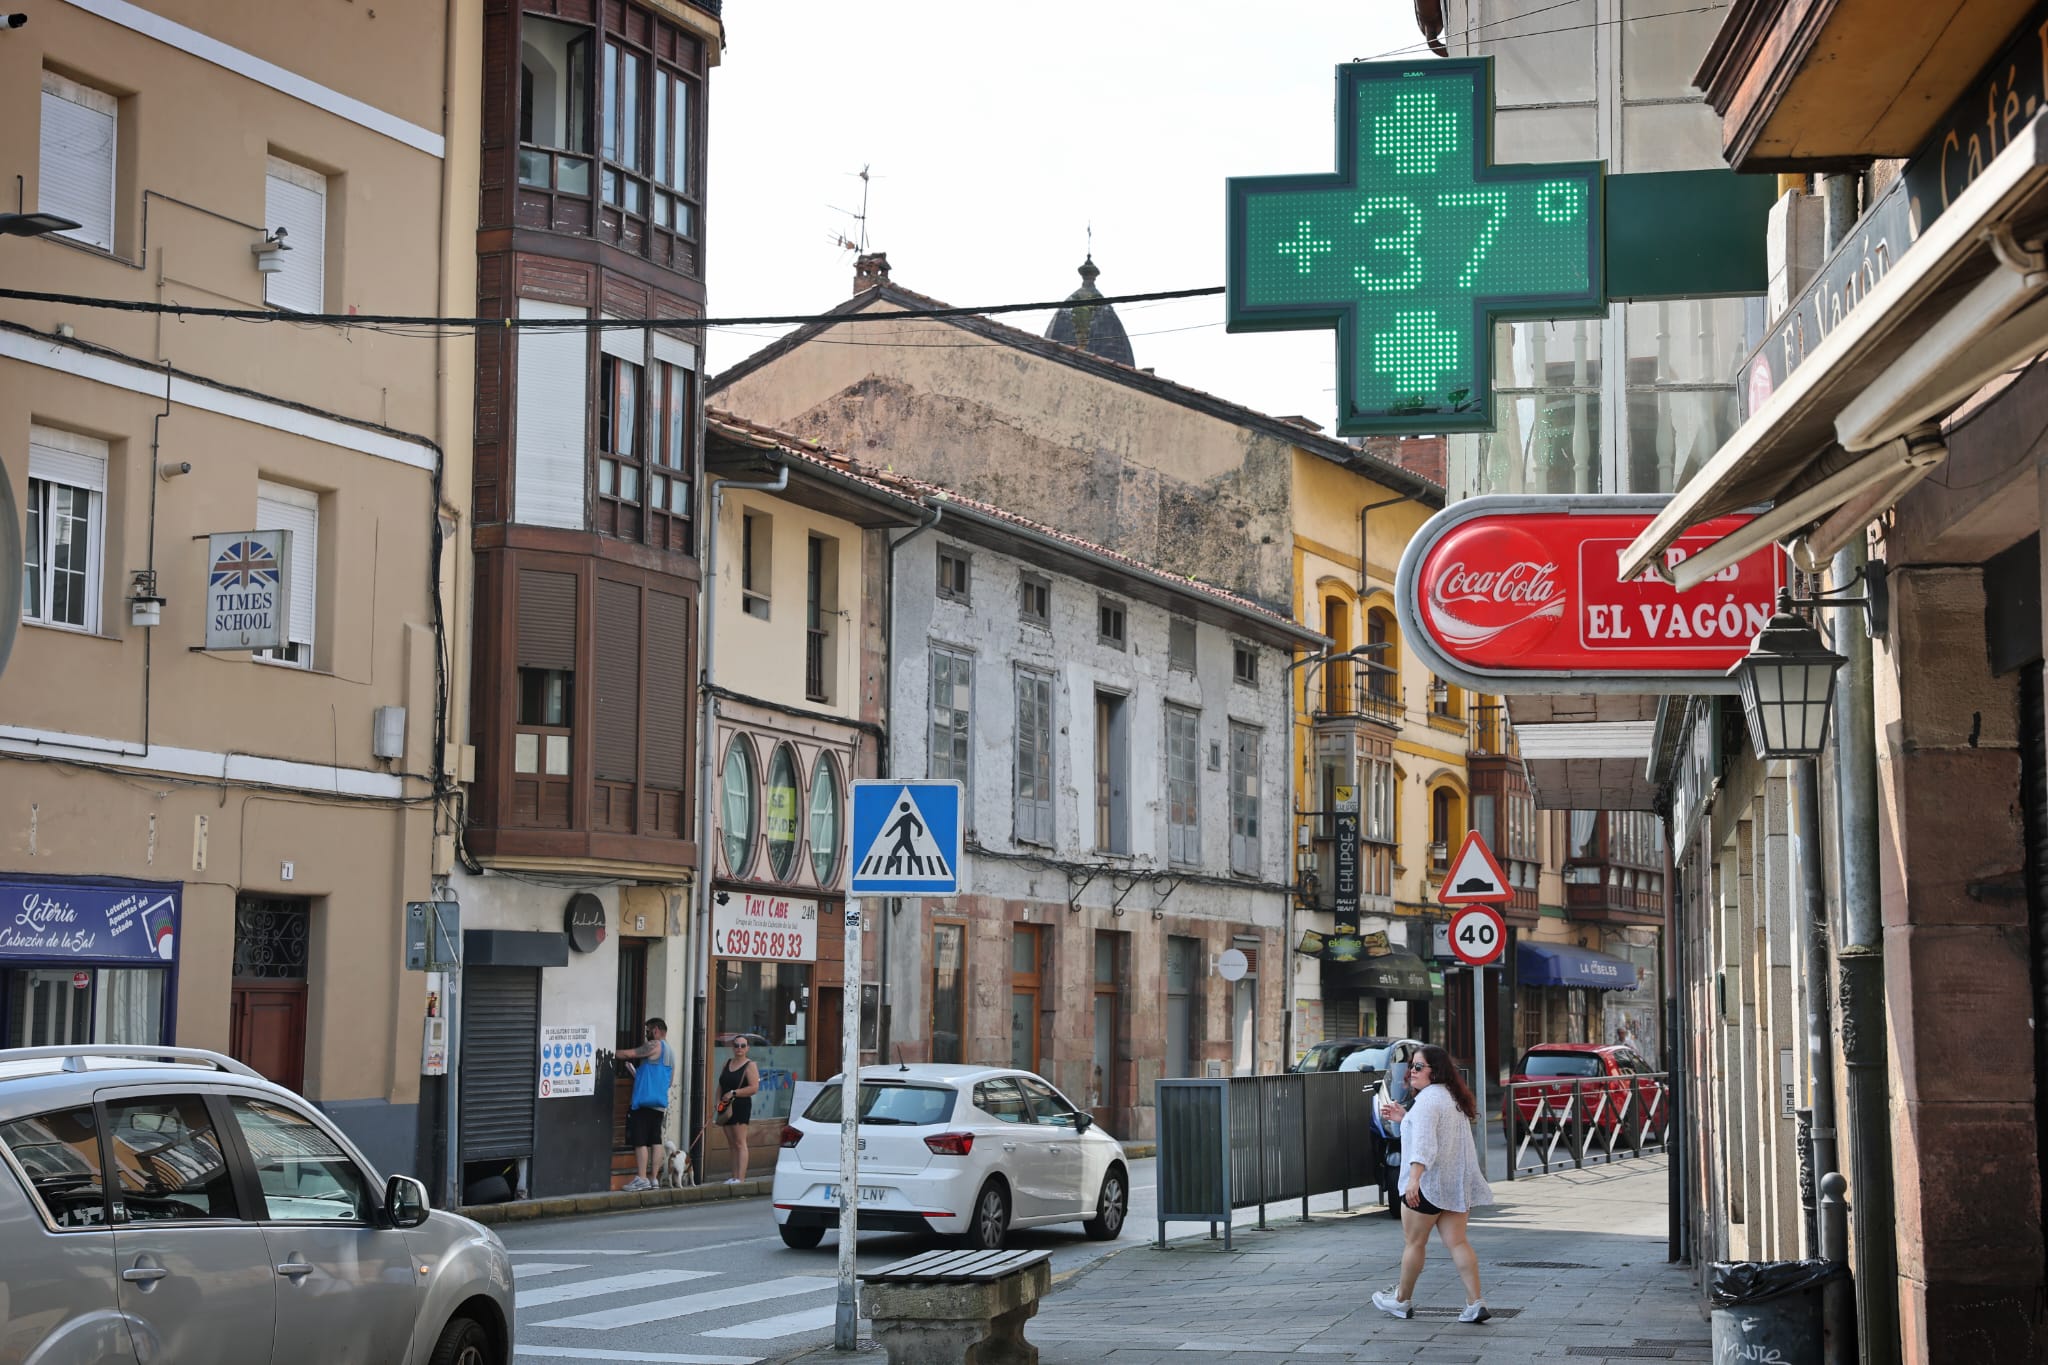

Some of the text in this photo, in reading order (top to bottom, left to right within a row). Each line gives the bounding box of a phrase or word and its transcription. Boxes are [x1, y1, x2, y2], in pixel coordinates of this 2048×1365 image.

[1435, 562, 1559, 603] Coca-Cola
[216, 592, 272, 612] TIMES
[215, 612, 272, 632] SCHOOL
[1588, 594, 1770, 639] EL VAGÓN
[109, 896, 149, 927] Apuestas del
[801, 905, 815, 920] 24h
[111, 919, 133, 937] Estado
[1459, 925, 1495, 944] 40
[45, 931, 59, 948] de
[727, 929, 802, 957] 639 56 89 33
[1580, 963, 1589, 973] LA
[862, 1188, 886, 1201] LNV
